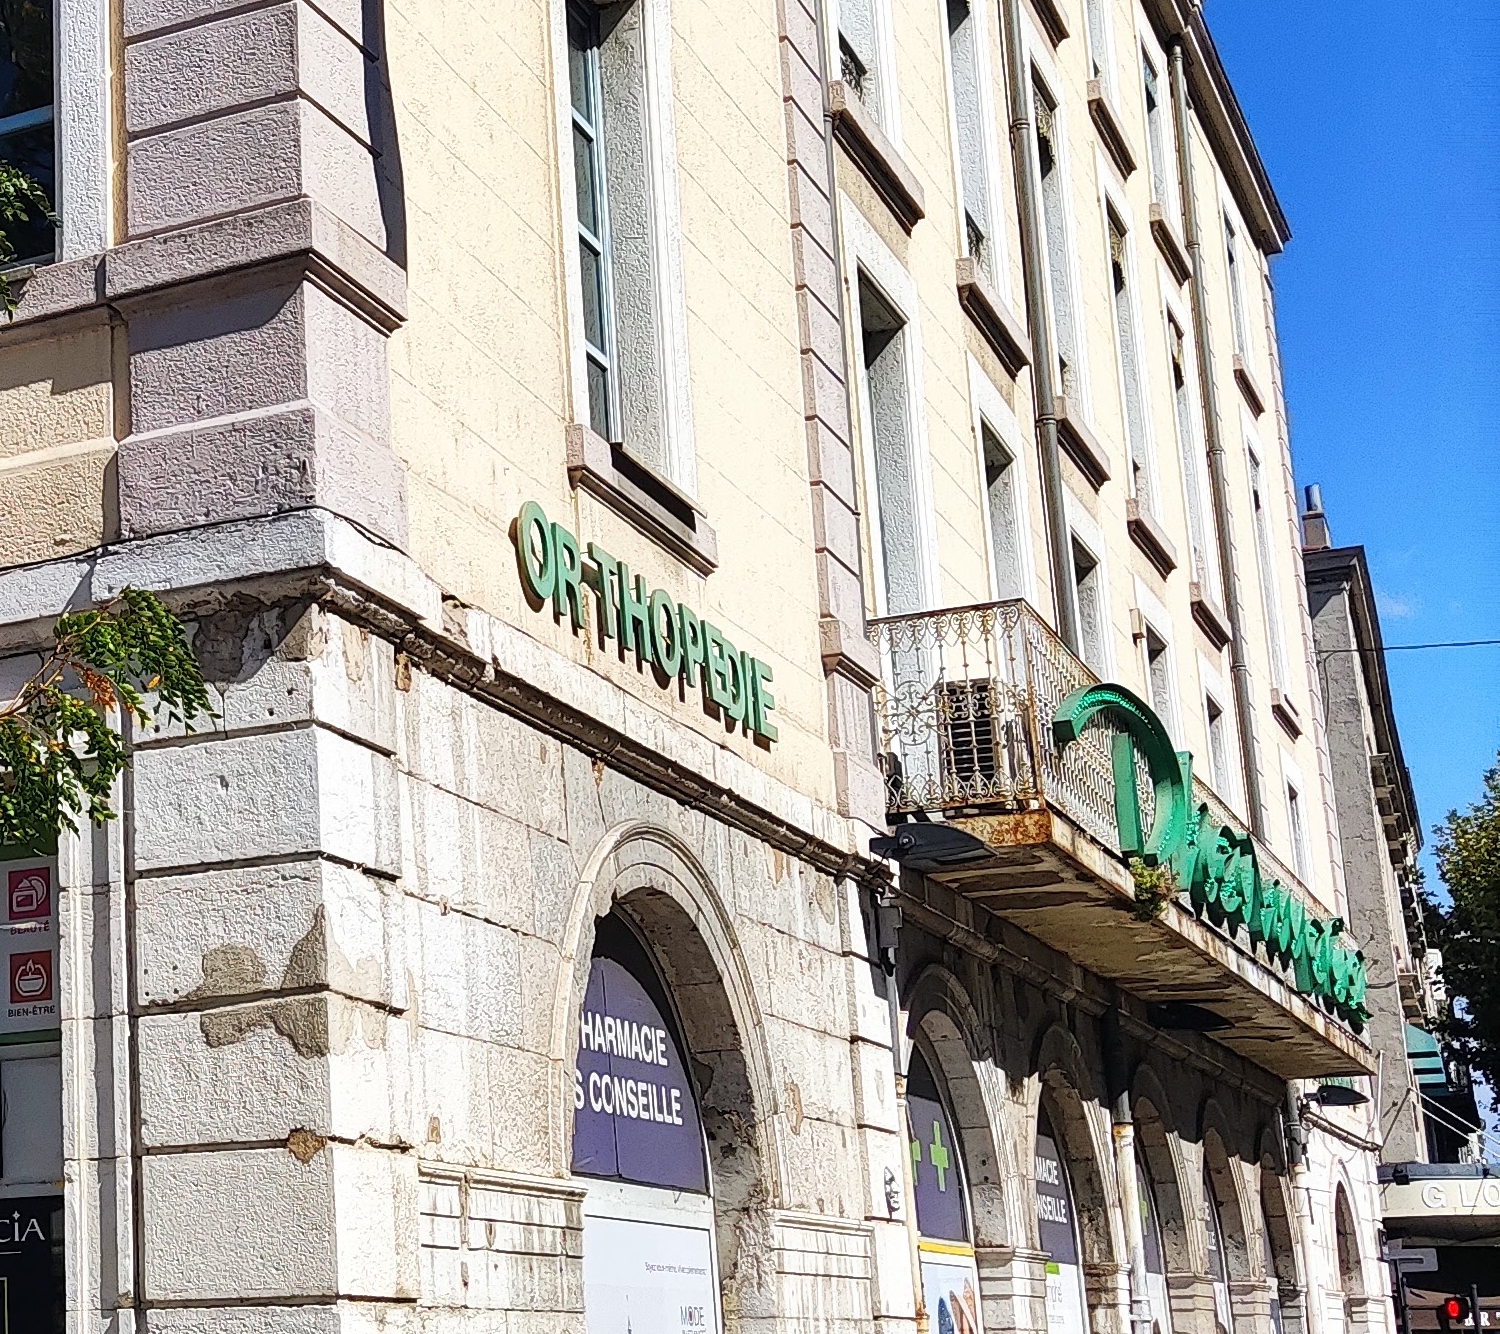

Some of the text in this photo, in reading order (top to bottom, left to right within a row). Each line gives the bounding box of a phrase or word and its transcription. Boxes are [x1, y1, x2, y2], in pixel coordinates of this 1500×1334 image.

[7, 1005, 55, 1018] BIEN-ÊTRE
[580, 1010, 668, 1066] HARMACIE
[589, 1073, 683, 1126] CONSEILLE
